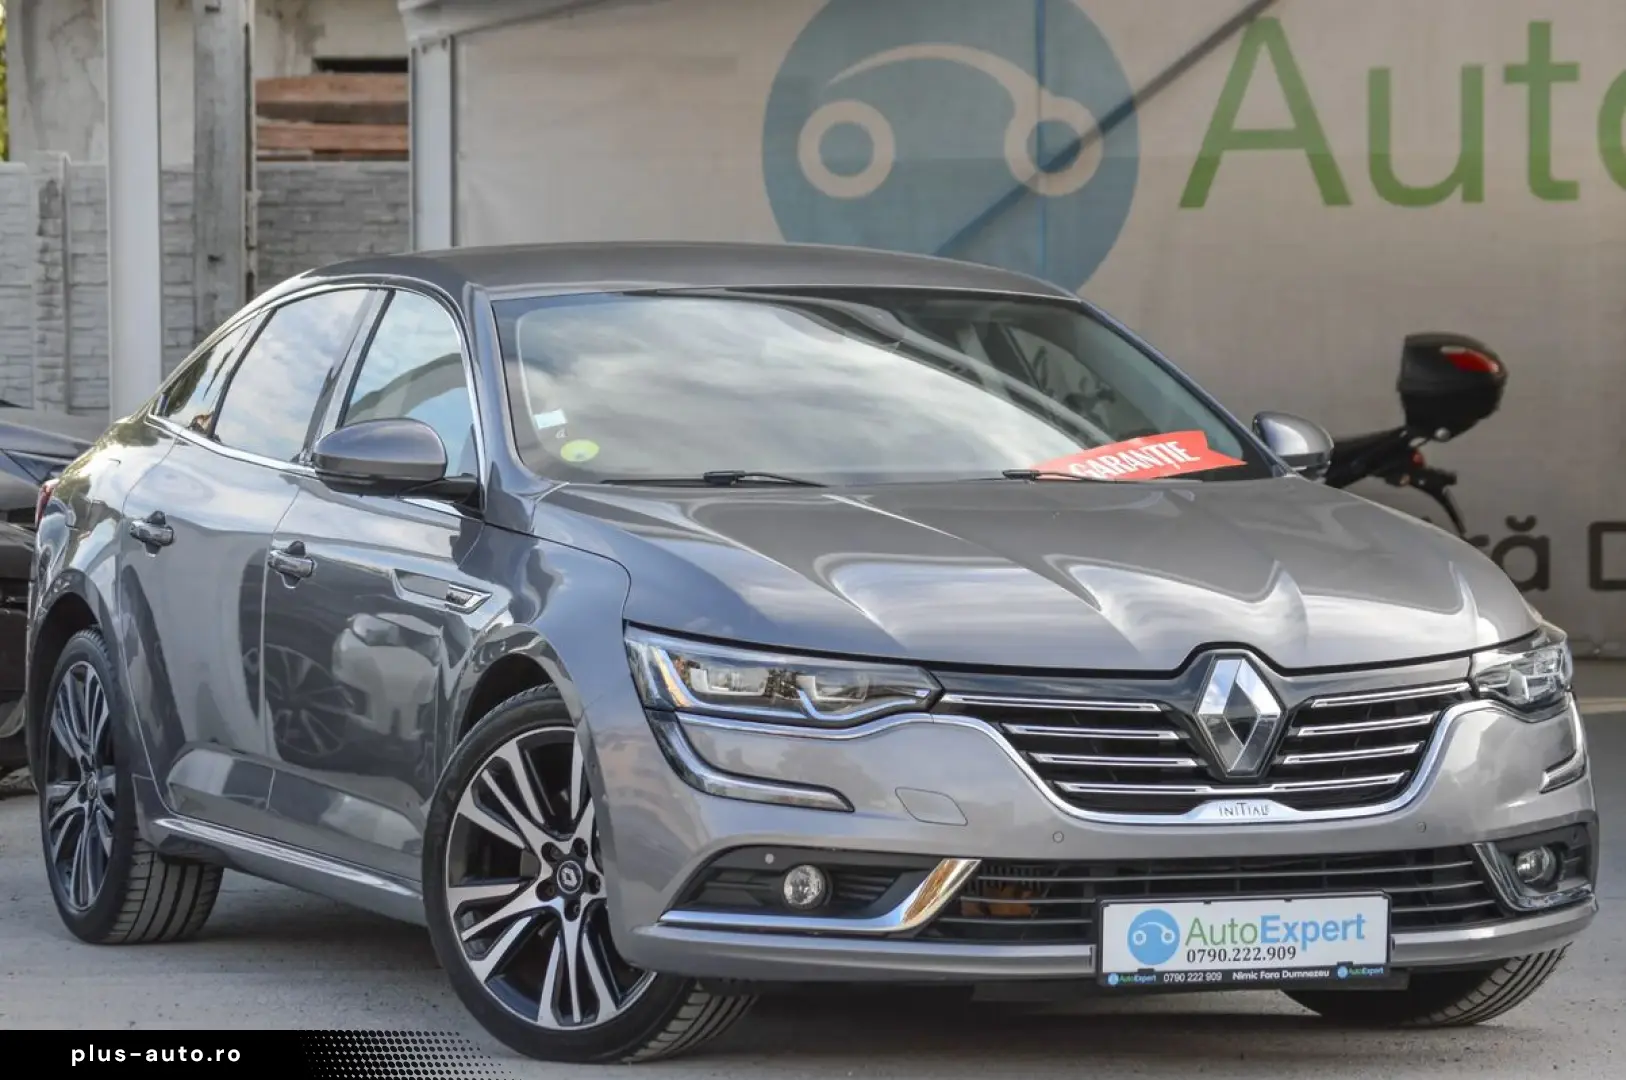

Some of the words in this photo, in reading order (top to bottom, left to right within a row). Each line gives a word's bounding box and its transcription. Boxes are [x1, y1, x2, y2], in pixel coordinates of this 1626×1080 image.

[1178, 16, 1626, 209] Aut
[1185, 913, 1366, 951] AutoExpert
[1186, 945, 1297, 964] 0790.222.909
[1163, 973, 1186, 983] 0790
[1187, 972, 1204, 983] 222
[1205, 971, 1223, 982] 909
[1232, 970, 1258, 981] Nimic
[1282, 968, 1330, 979] Dumnezeu
